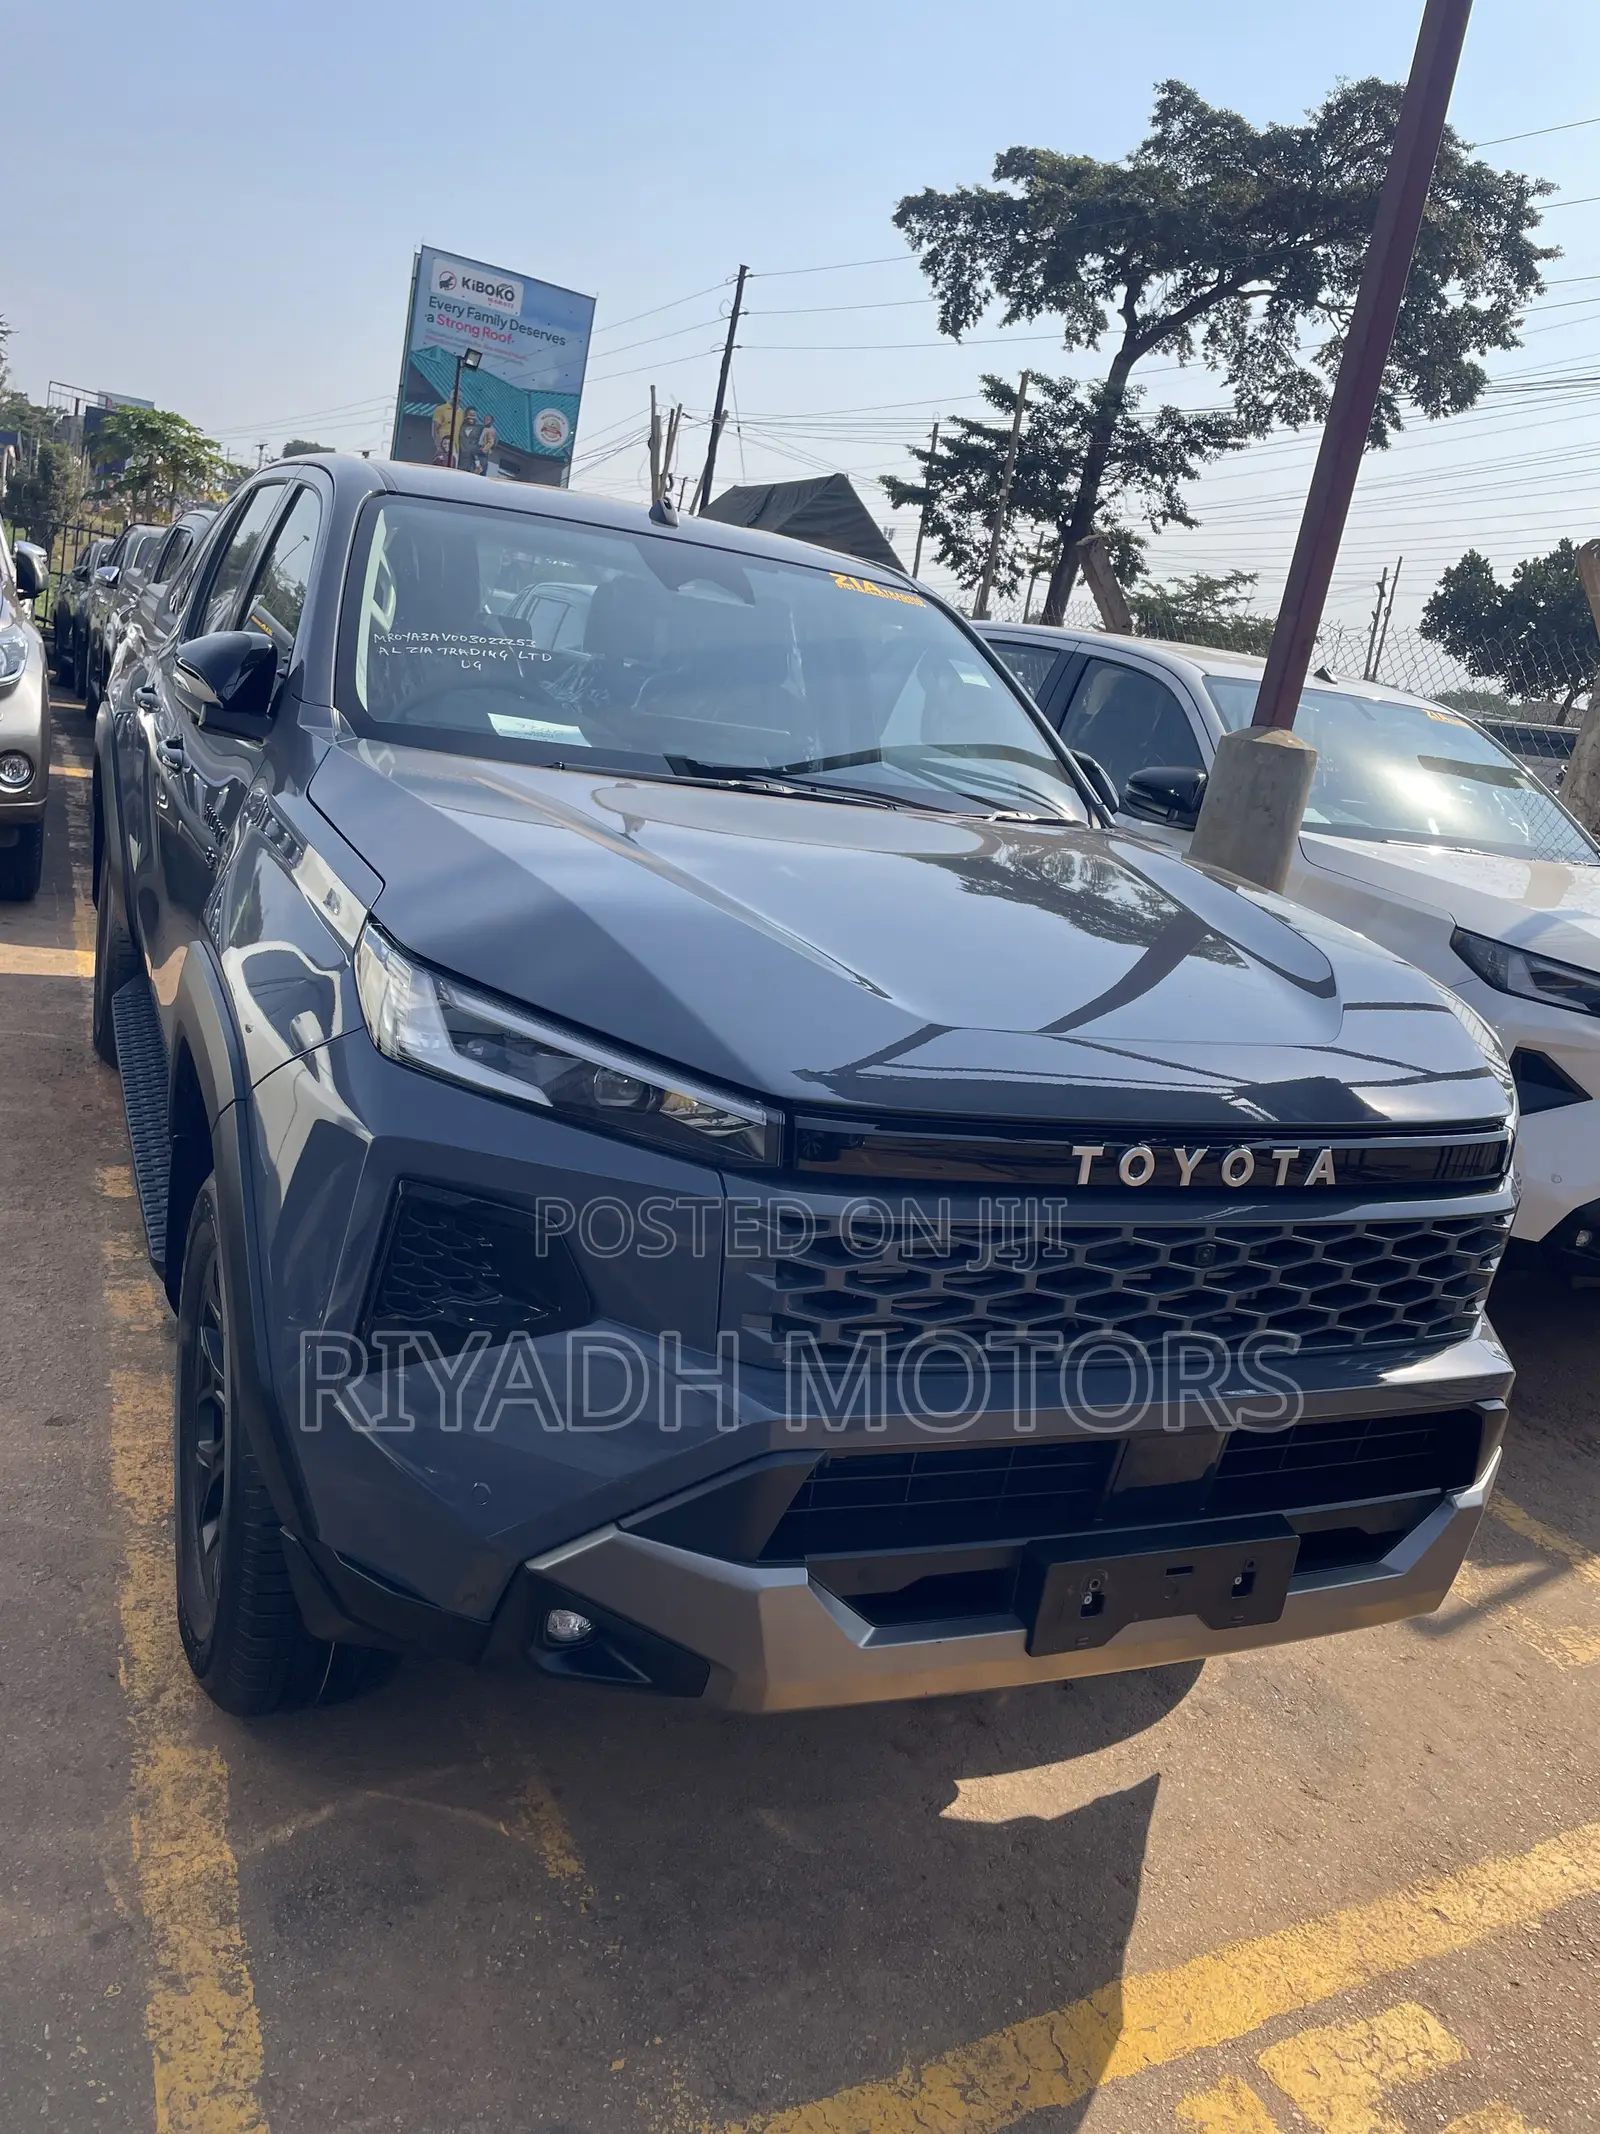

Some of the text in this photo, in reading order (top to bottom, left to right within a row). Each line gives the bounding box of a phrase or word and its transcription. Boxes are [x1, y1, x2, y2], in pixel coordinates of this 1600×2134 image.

[461, 277, 515, 302] KiBOKO
[426, 313, 513, 344] a Strong Roof
[429, 296, 465, 318] Every
[467, 306, 508, 331] Family
[509, 318, 567, 346] Deserves
[378, 646, 402, 656] AL
[437, 646, 508, 661] TRADING
[518, 650, 552, 662] LTD
[1072, 1144, 1337, 1187] TOYOTA
